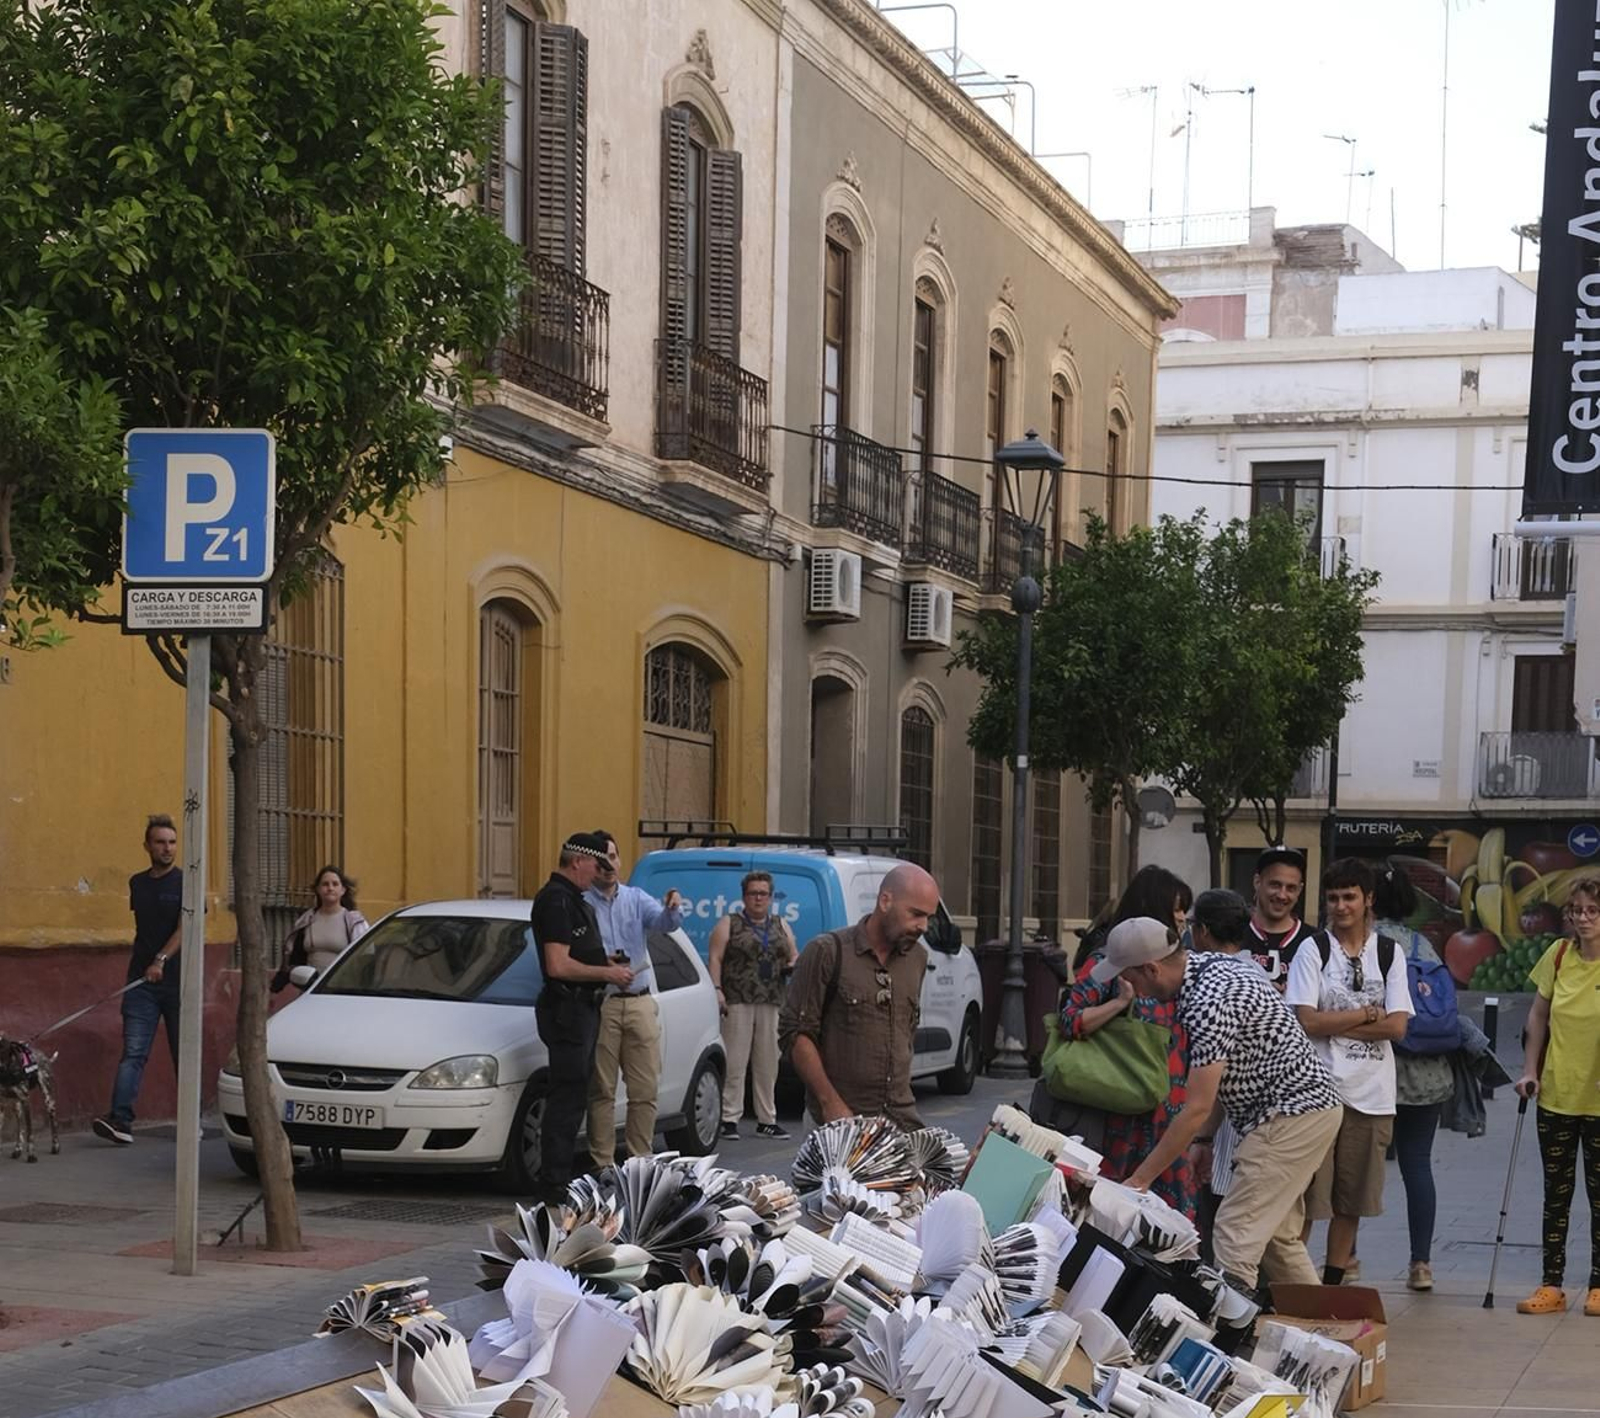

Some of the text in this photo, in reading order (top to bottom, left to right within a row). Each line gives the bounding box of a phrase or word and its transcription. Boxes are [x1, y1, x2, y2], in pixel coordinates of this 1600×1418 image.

[165, 453, 236, 562] P
[203, 527, 248, 561] Z1
[131, 591, 257, 603] CARGA Y DESCARGA
[1335, 821, 1404, 834] RUTERÍA
[295, 1103, 375, 1125] 7588 DYP
